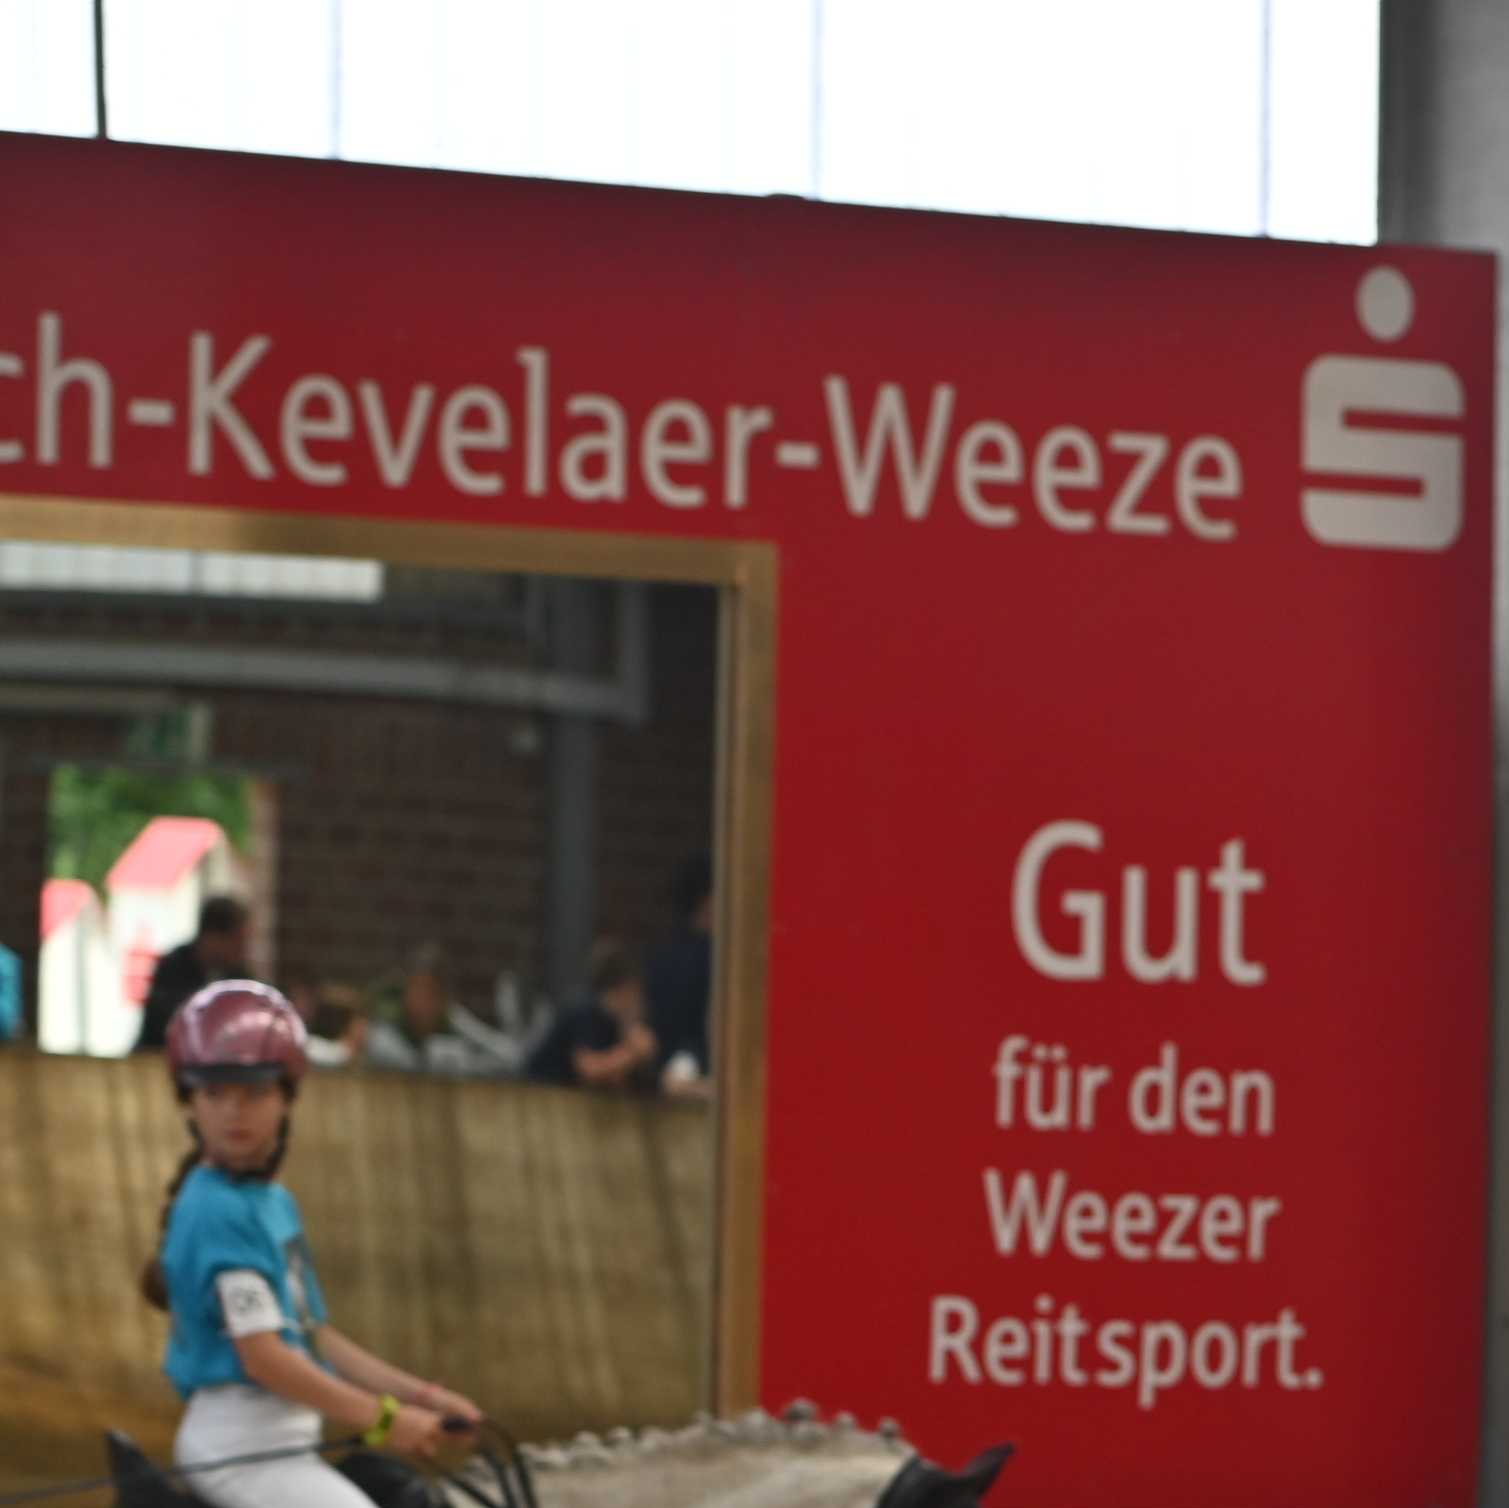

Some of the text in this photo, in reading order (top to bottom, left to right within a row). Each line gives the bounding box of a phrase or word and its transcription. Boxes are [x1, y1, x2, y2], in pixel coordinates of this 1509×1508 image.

[1011, 819, 1268, 986] Gut
[993, 1035, 1277, 1136] für den
[983, 1167, 1281, 1262] Weezer
[929, 1294, 1323, 1410] Reitsport.
